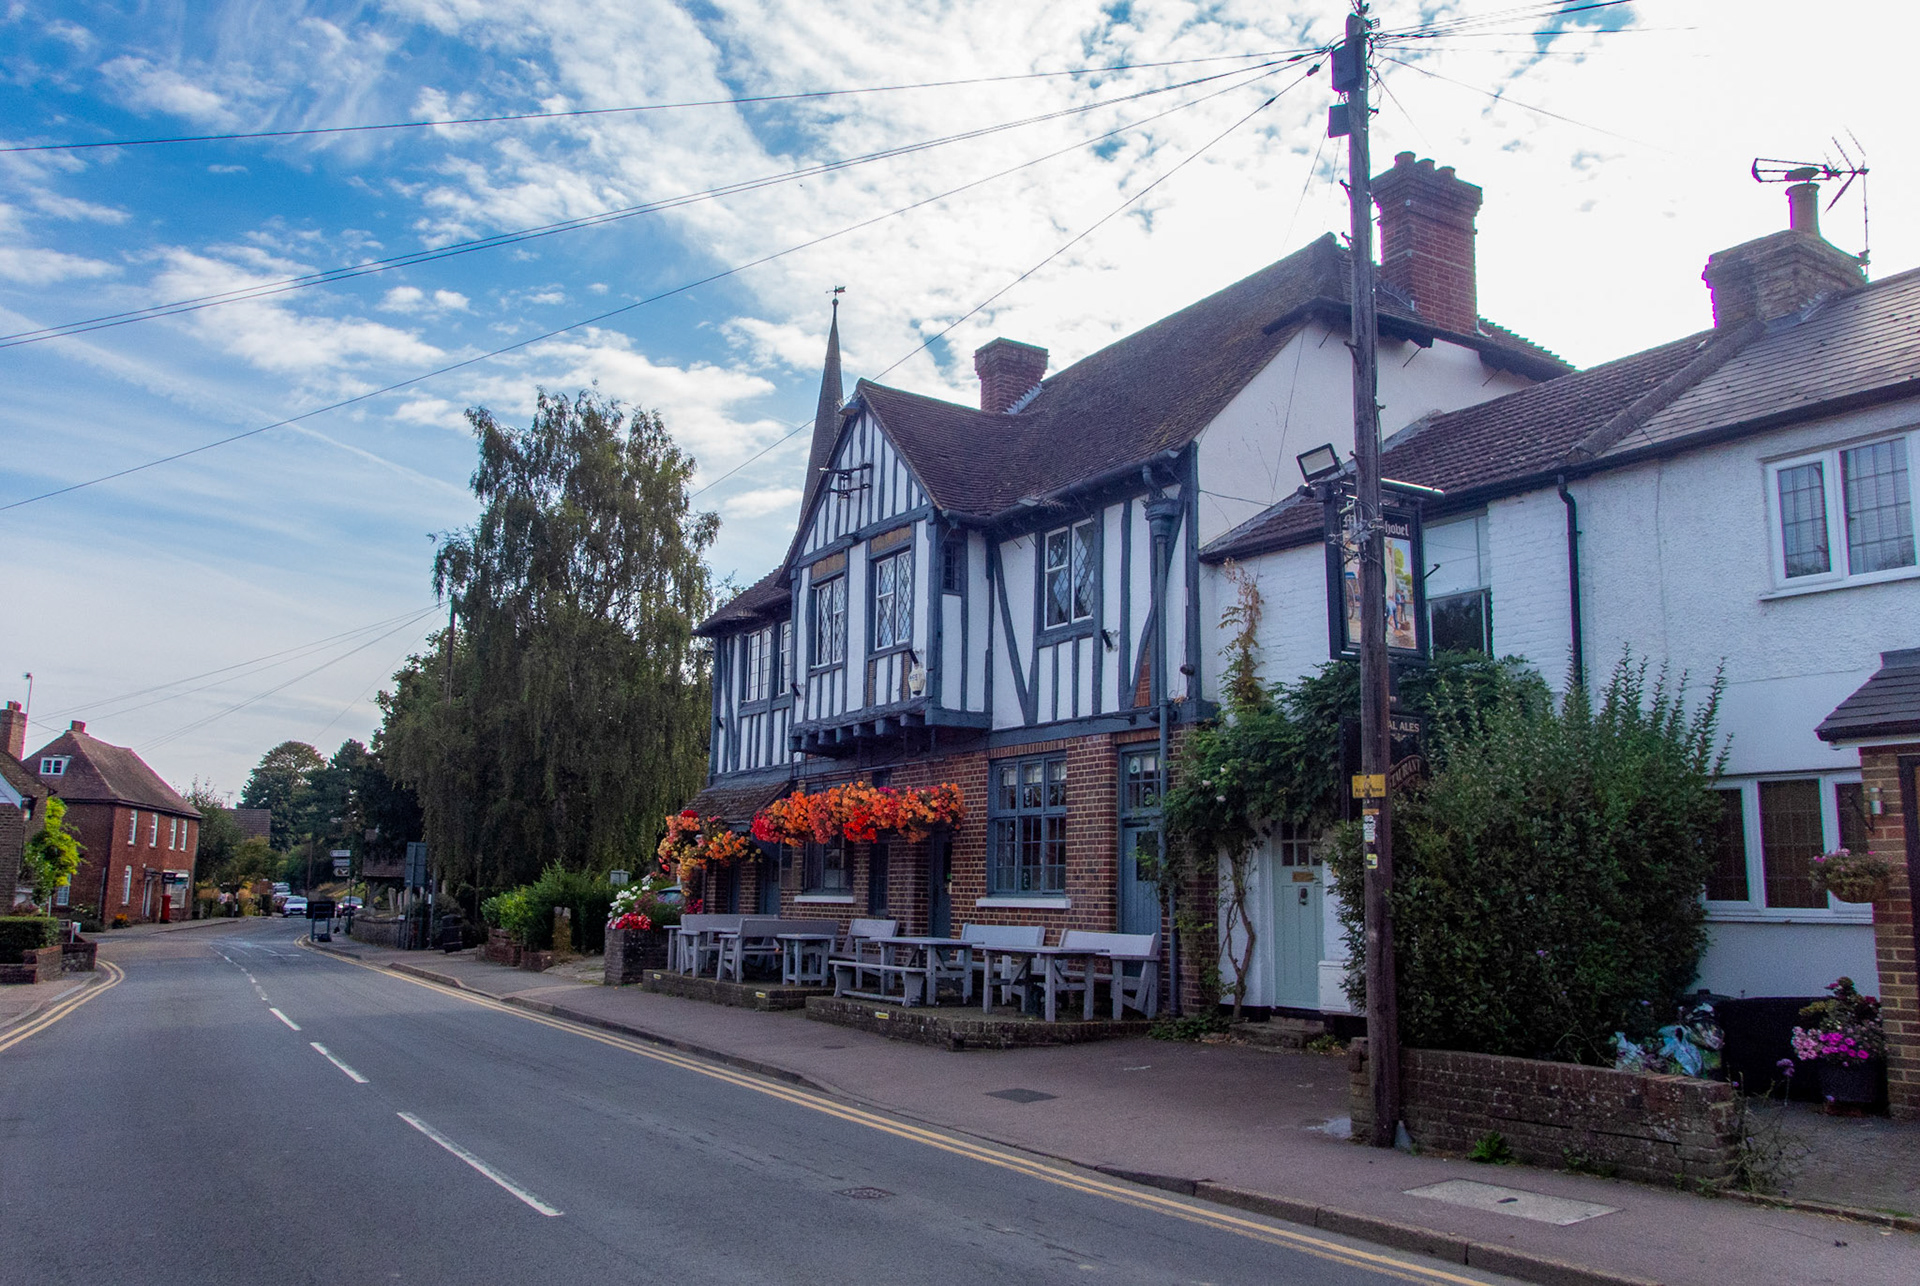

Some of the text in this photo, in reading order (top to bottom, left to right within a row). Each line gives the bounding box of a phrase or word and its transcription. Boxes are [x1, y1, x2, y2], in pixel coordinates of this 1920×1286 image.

[1384, 520, 1409, 537] hovel
[1387, 720, 1420, 732] AL ALES
